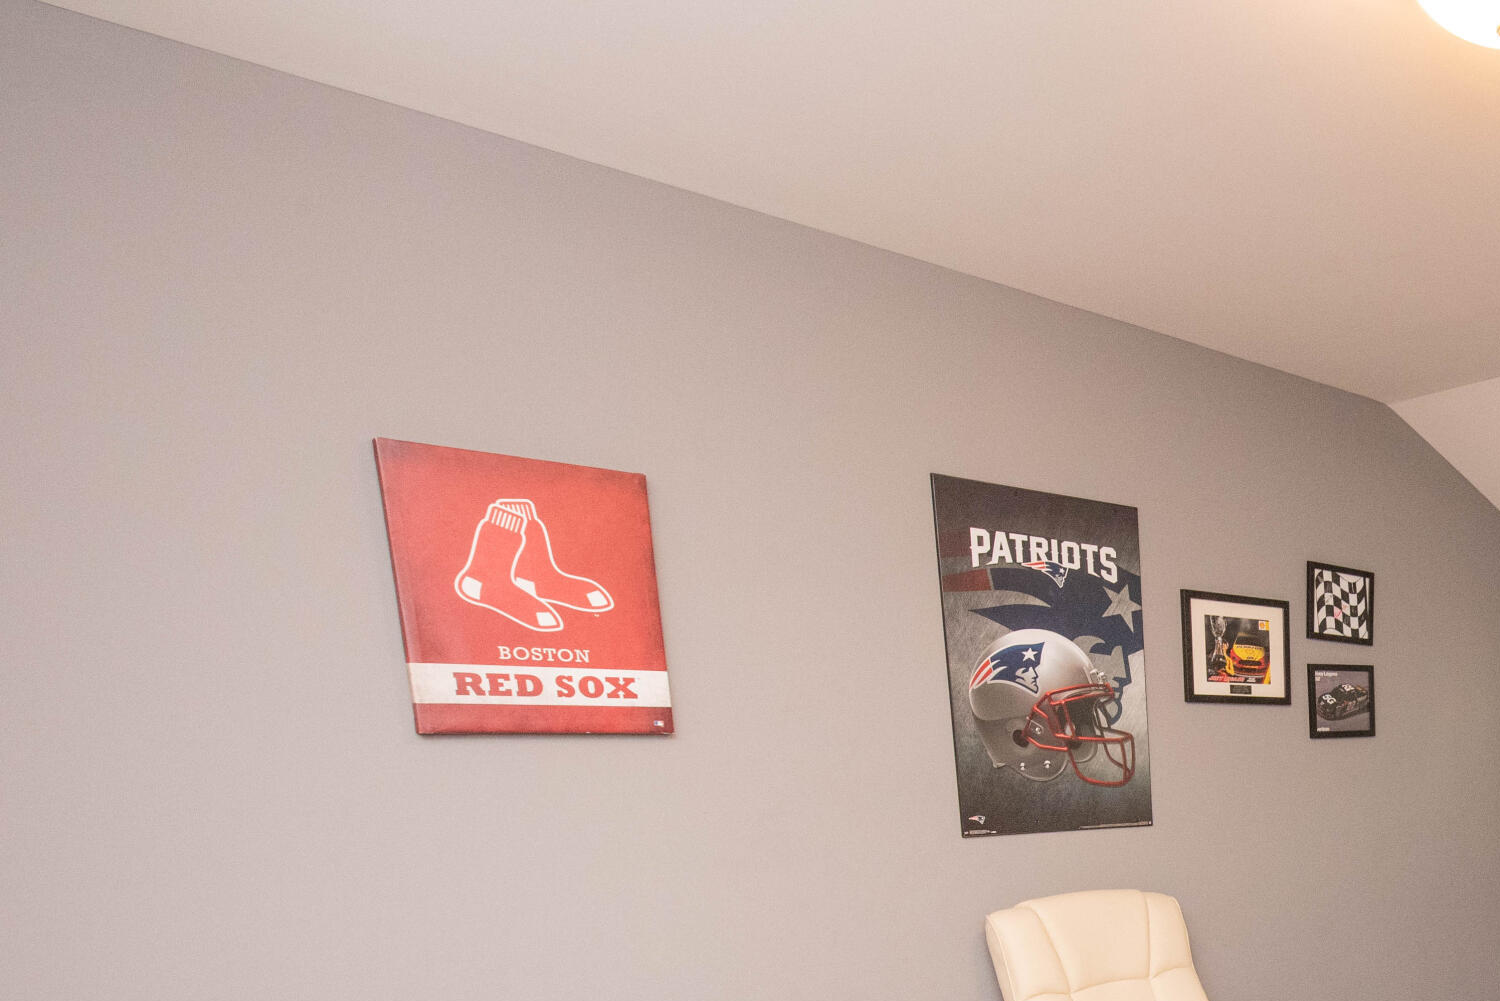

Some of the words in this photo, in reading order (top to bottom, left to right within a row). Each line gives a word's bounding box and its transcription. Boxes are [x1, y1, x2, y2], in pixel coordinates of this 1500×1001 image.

[969, 527, 1118, 584] PATRIOTS
[497, 645, 590, 664] BOSTON
[453, 672, 544, 697] RED
[556, 675, 639, 700] SOX
